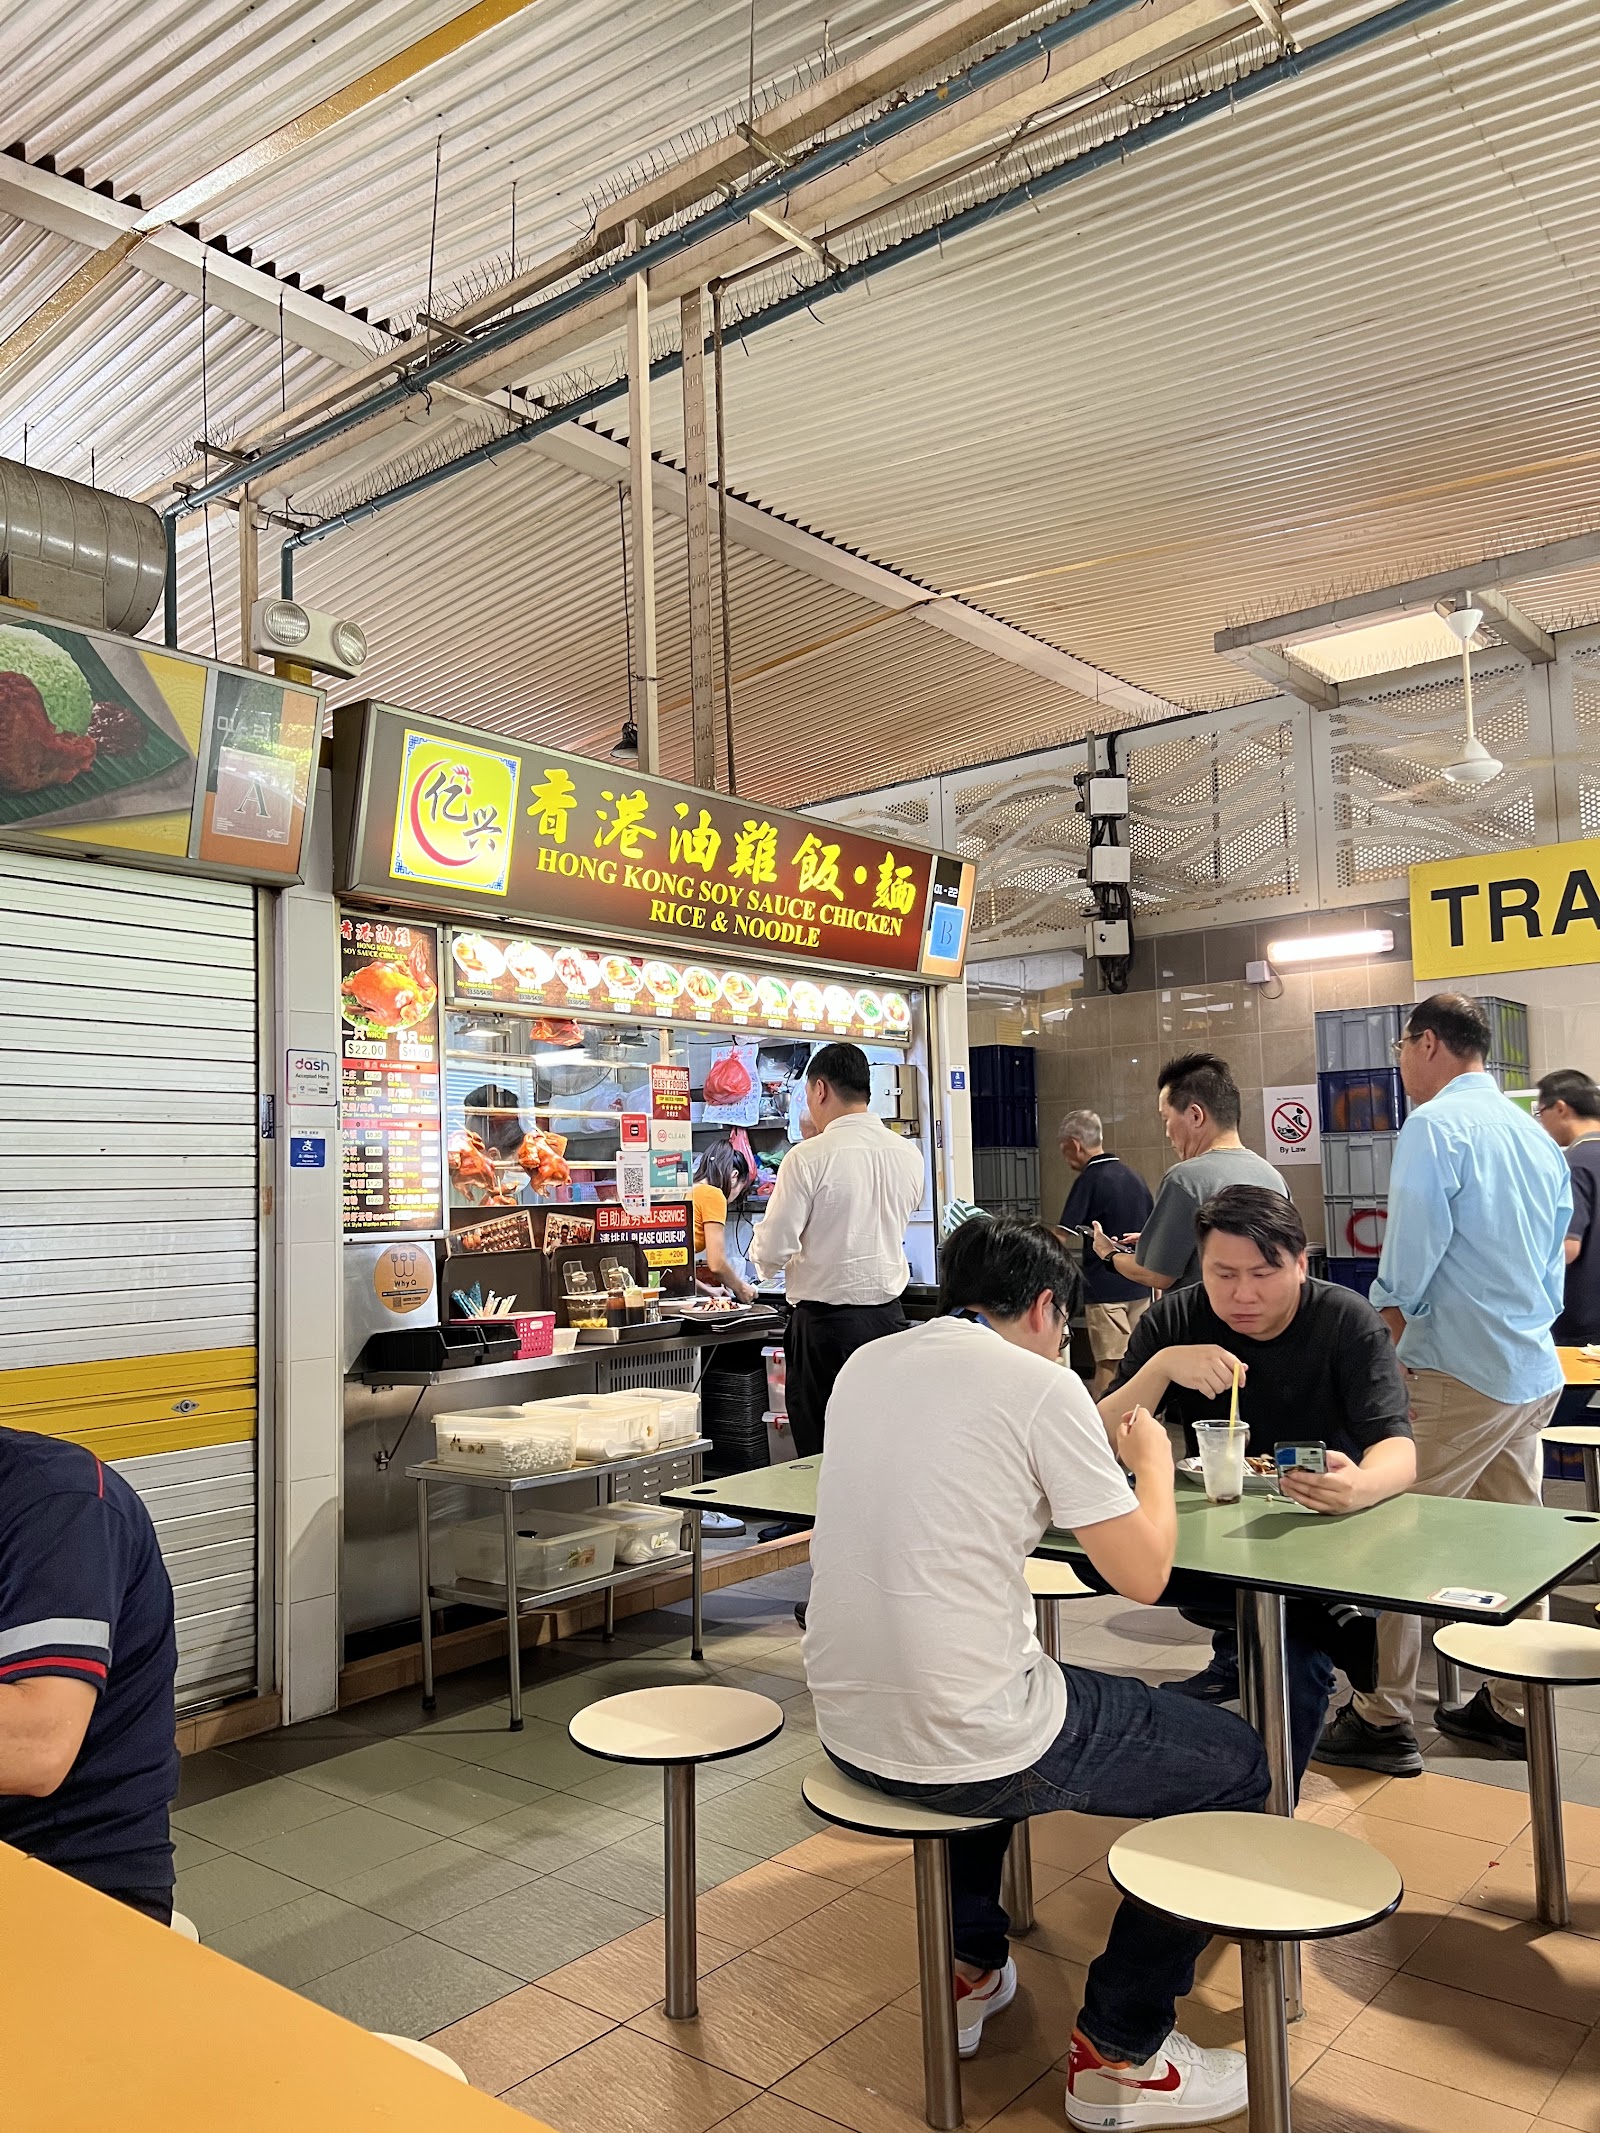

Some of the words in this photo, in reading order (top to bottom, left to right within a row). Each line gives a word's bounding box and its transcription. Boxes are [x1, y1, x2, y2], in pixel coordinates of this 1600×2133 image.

[234, 780, 271, 818] A
[425, 771, 502, 850] 亿兴
[536, 847, 617, 884] HONG
[622, 865, 695, 899] KONG
[699, 880, 744, 908] SOY
[747, 890, 816, 921] SAUCE
[820, 904, 903, 937] CHICKEN
[934, 884, 959, 898] 01-22
[1431, 869, 1600, 947] TRA
[649, 899, 706, 930] RICE
[711, 912, 729, 933] &
[733, 914, 821, 948] NOODLE
[940, 920, 953, 945] B
[343, 948, 356, 956] SOY
[357, 949, 379, 958] SAUCE
[380, 952, 408, 960] CHICKEN
[357, 942, 376, 951] HONG
[377, 944, 396, 953] KONG
[366, 1030, 388, 1040] WHOLE
[348, 1043, 384, 1056] $22.00
[295, 1058, 330, 1071] dash
[653, 1068, 689, 1080] SINGAPORE
[654, 1080, 668, 1088] BEST
[670, 1081, 688, 1089] FOODS
[642, 1209, 685, 1224] SELF-SERVICE
[656, 1230, 686, 1243] QUEUE-UP
[1102, 2118, 1116, 2127] AIR
